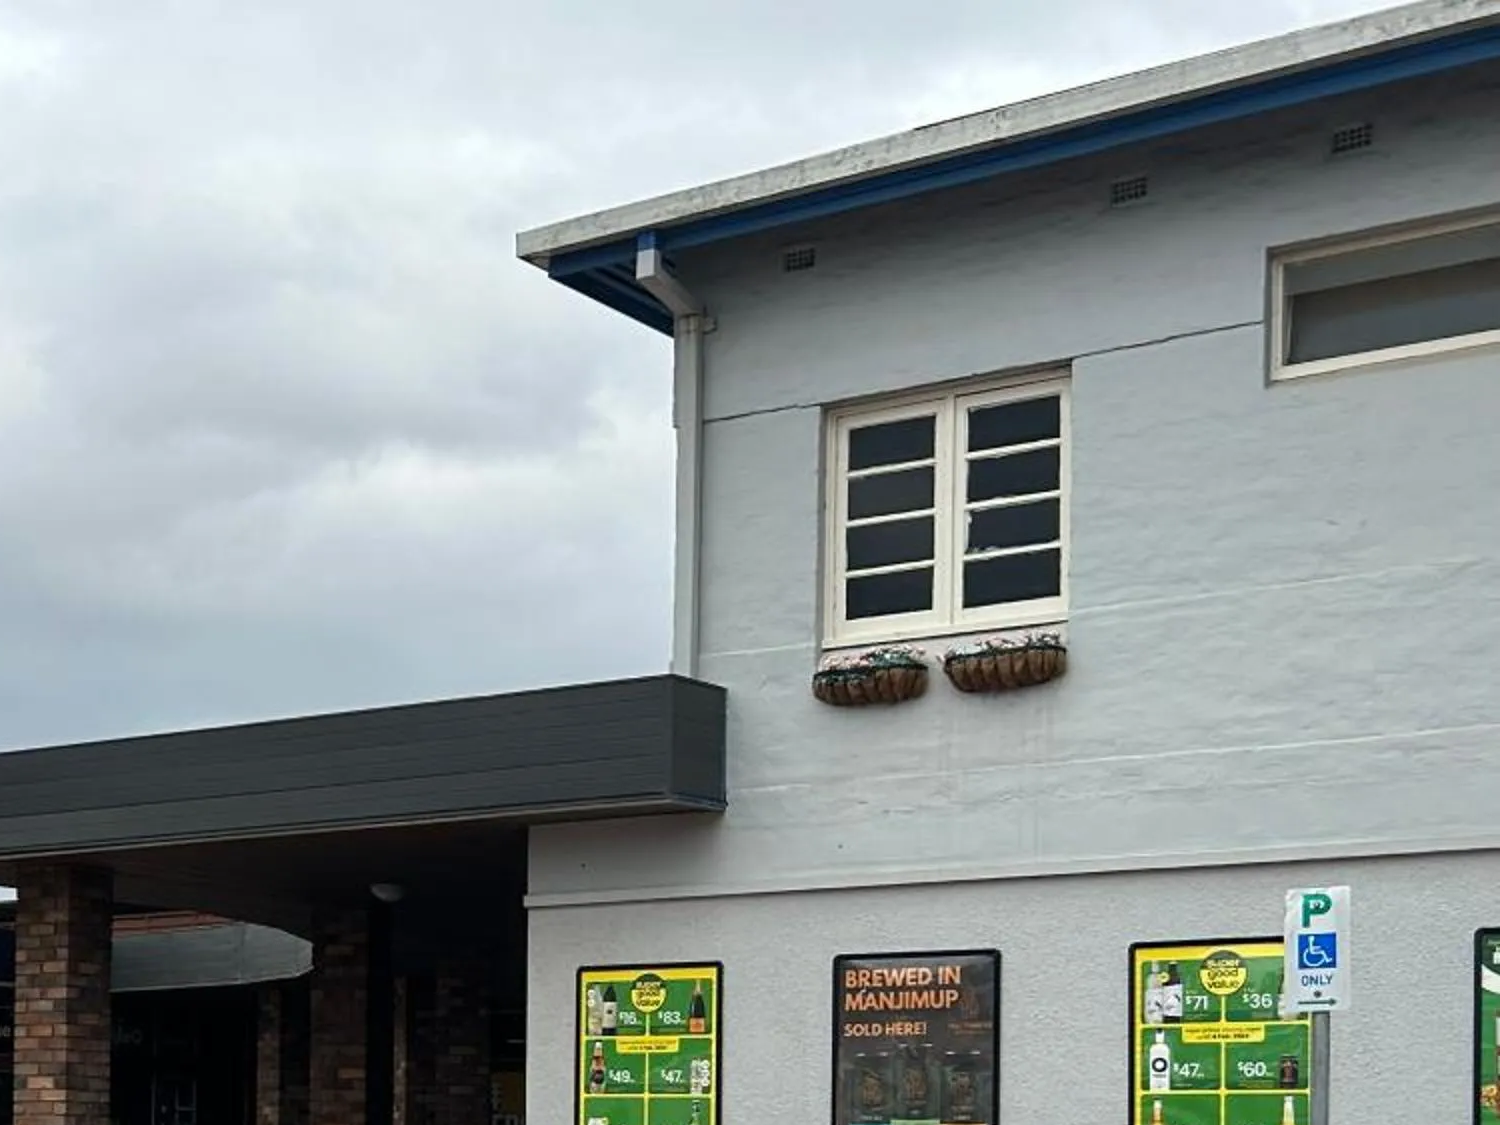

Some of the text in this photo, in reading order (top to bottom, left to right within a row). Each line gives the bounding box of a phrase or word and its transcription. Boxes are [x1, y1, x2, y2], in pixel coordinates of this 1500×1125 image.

[1302, 893, 1332, 928] P
[845, 965, 962, 988] BREWED IN
[1301, 975, 1333, 986] ONLY
[845, 990, 959, 1012] MANJIMUP
[1242, 993, 1273, 1009] $36
[844, 1022, 927, 1037] SOLD HERE!
